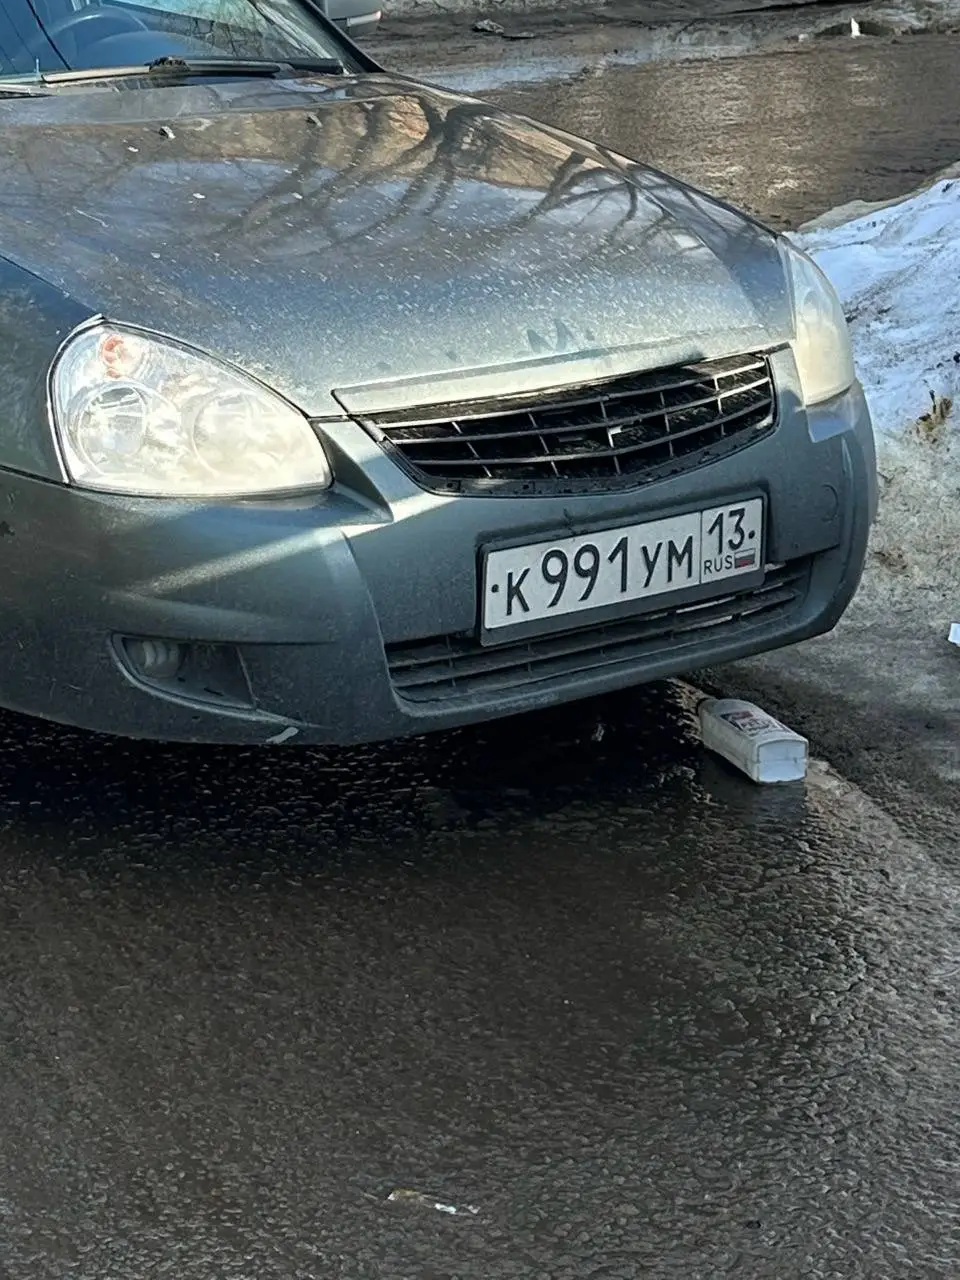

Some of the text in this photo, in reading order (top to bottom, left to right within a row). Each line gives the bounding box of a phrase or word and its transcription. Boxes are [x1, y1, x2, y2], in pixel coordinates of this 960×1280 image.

[505, 507, 746, 616] К991УМ 13
[703, 554, 734, 575] RUS
